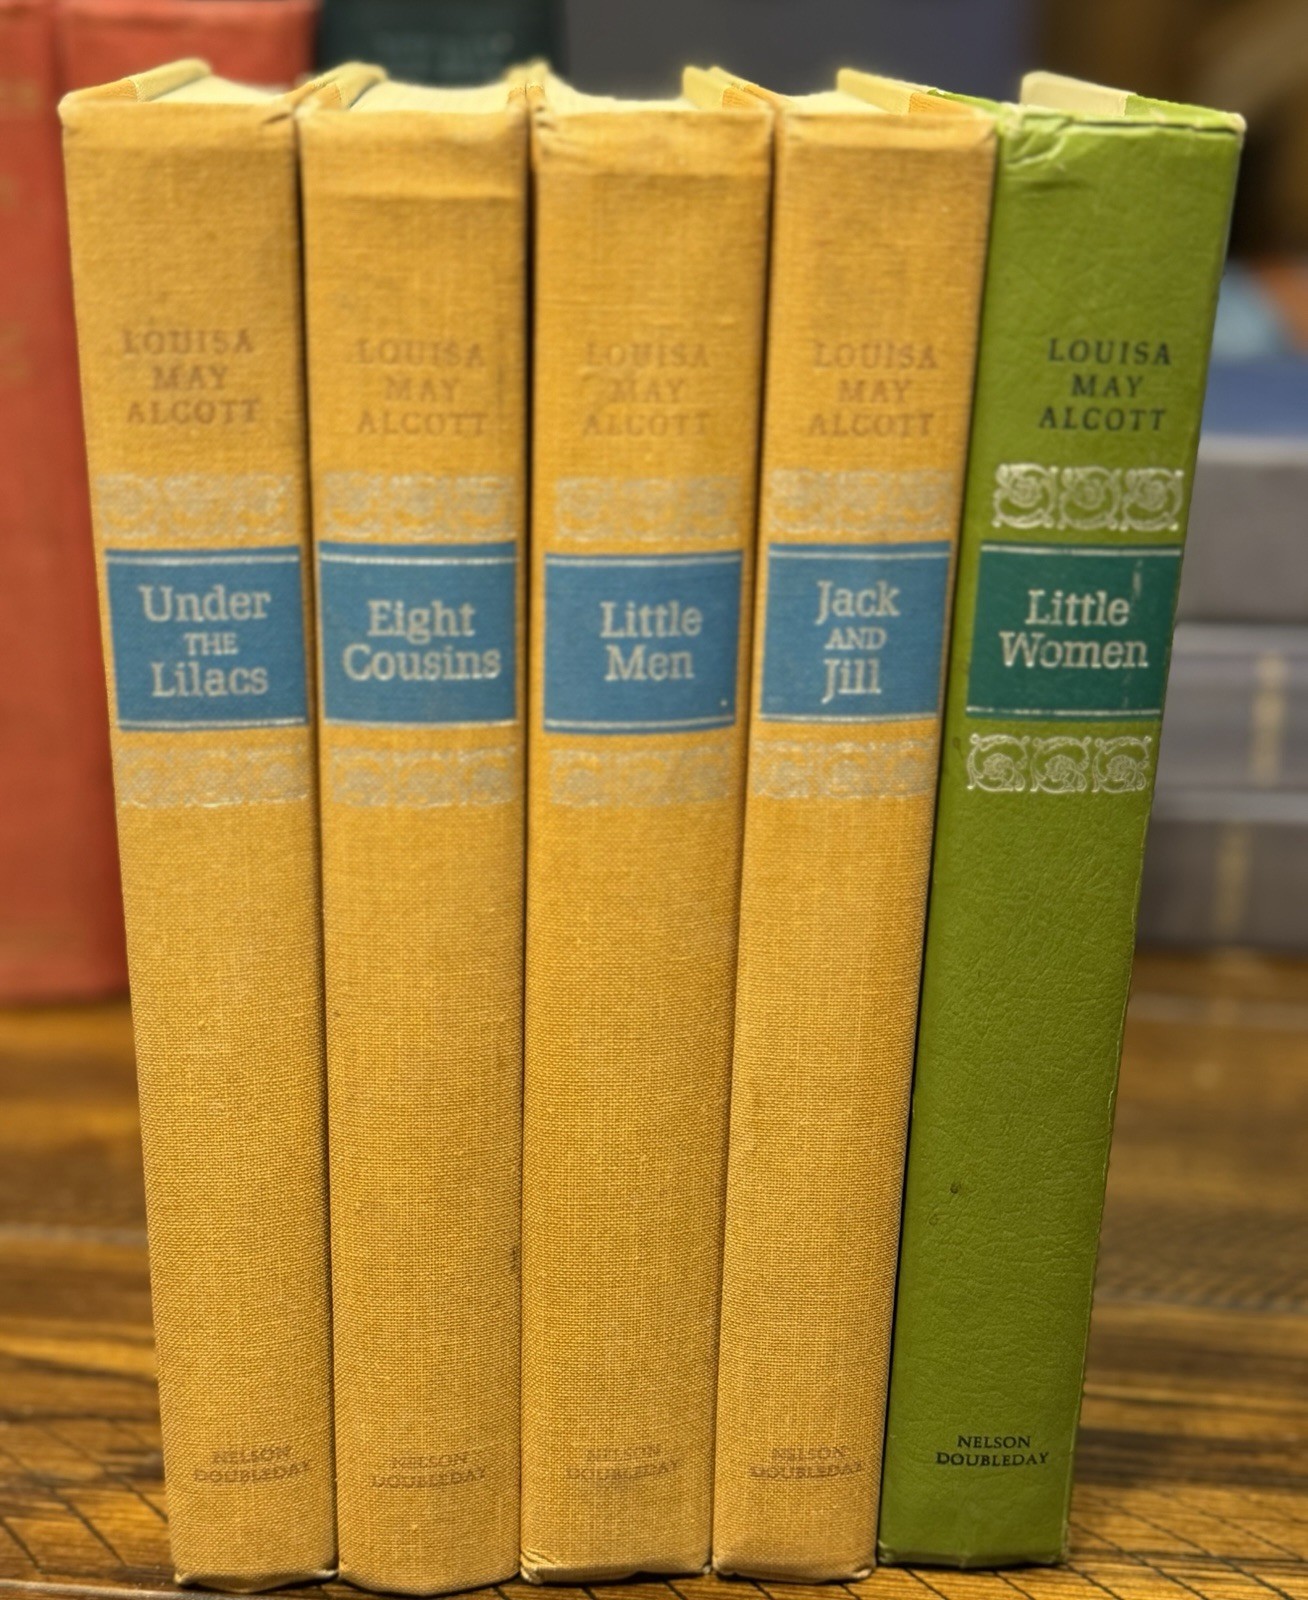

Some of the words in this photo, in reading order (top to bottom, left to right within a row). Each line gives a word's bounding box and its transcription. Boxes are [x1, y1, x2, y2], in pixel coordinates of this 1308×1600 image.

[121, 329, 255, 356] LOUISA
[356, 338, 486, 368] LOUISA
[587, 341, 710, 368] LOUISA
[812, 340, 938, 370] LOUISA
[1048, 338, 1171, 365] LOUISA
[151, 365, 229, 391] MAY
[384, 377, 461, 402] MAY
[613, 378, 685, 403] MAY
[838, 378, 912, 404] MAY
[1071, 374, 1143, 398] MAY
[126, 399, 260, 425] ALCOTT
[356, 410, 489, 437] ALCOTT
[582, 412, 710, 437] ALCOTT
[808, 413, 934, 437] ALCOTT
[1038, 406, 1166, 431] ALCOTT
[138, 584, 271, 622] Under
[815, 580, 901, 626] Jack
[1025, 589, 1130, 626] Little
[367, 599, 476, 645] Eight
[600, 600, 703, 638] Little
[183, 632, 238, 656] THE
[824, 627, 888, 650] AND
[999, 631, 1149, 669] Women
[342, 643, 501, 681] Cousins
[604, 644, 695, 681] Men
[151, 661, 269, 697] Lilacs
[822, 658, 882, 704] Jill
[957, 1435, 1031, 1449] NELSON
[936, 1452, 1049, 1467] DOUBLEDAY
